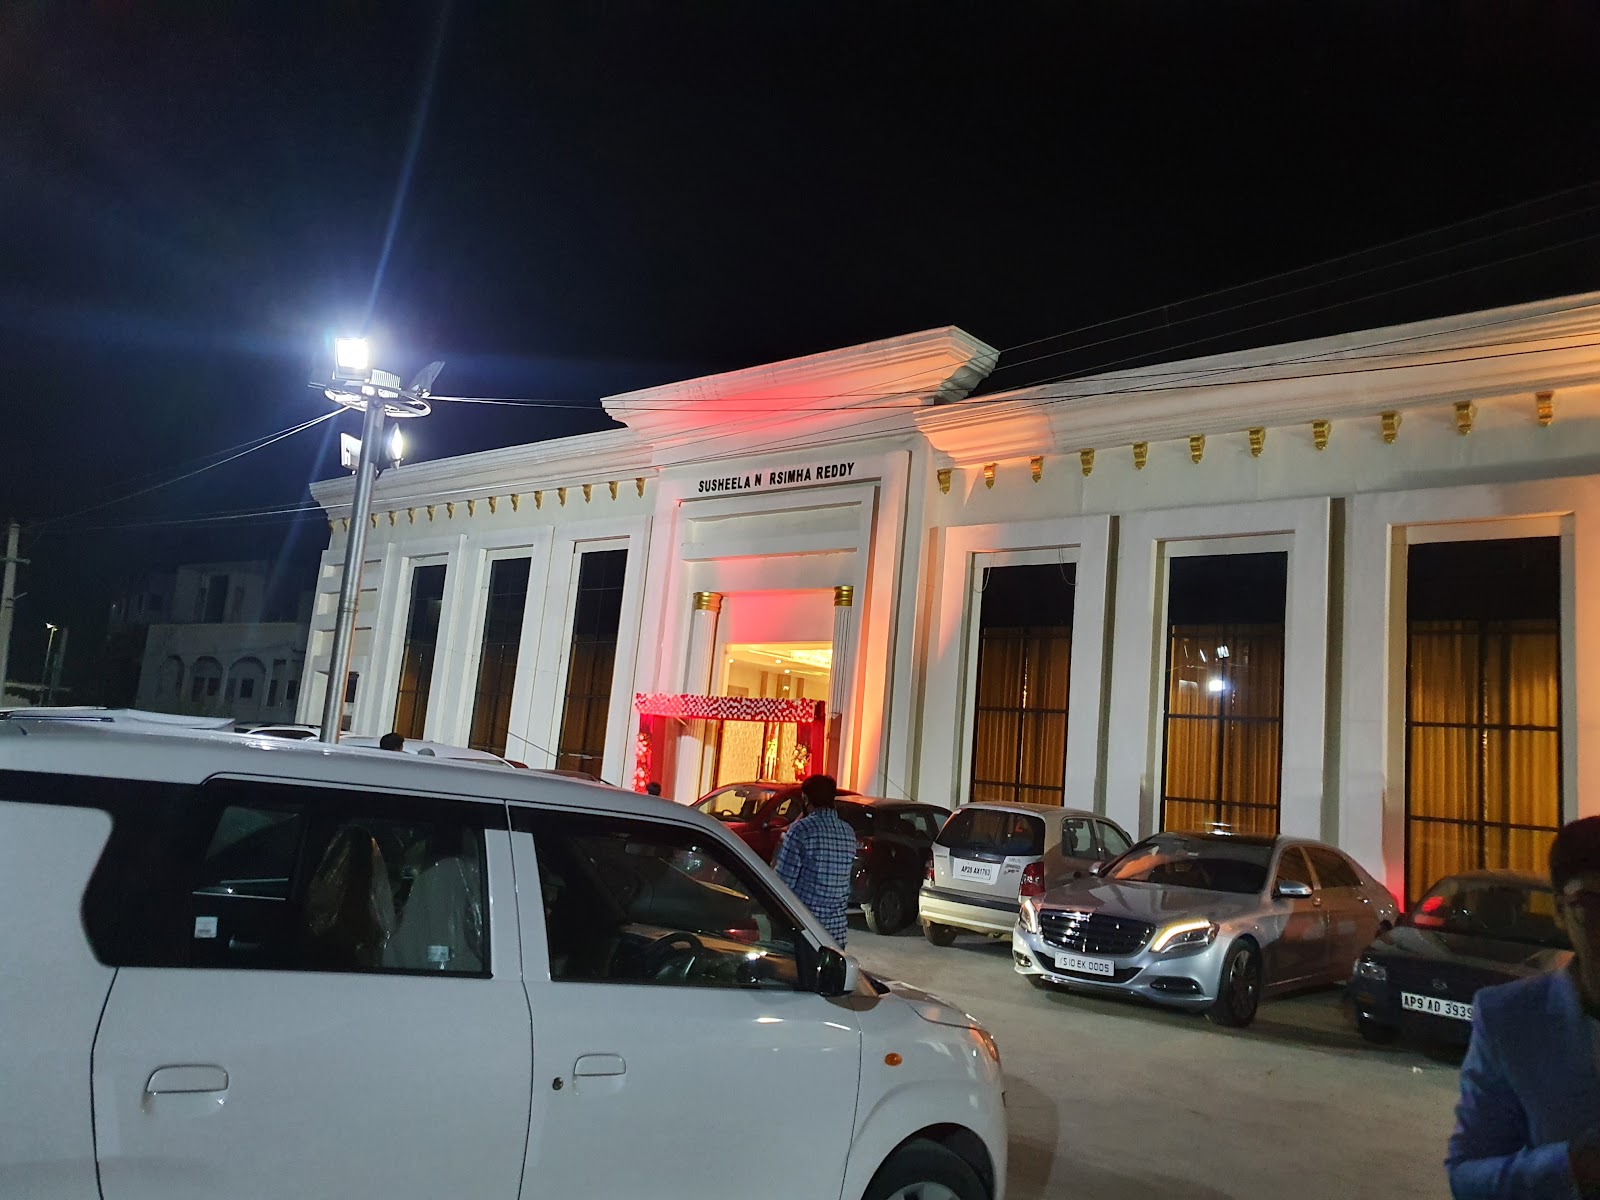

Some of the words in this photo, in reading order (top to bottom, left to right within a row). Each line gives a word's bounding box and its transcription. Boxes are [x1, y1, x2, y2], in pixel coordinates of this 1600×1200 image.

[698, 476, 751, 493] SUSHEELA
[816, 462, 855, 480] REDDY
[1077, 960, 1087, 970] EK
[1088, 961, 1110, 973] 0005
[1404, 995, 1424, 1009] AP9
[1427, 999, 1441, 1012] AD
